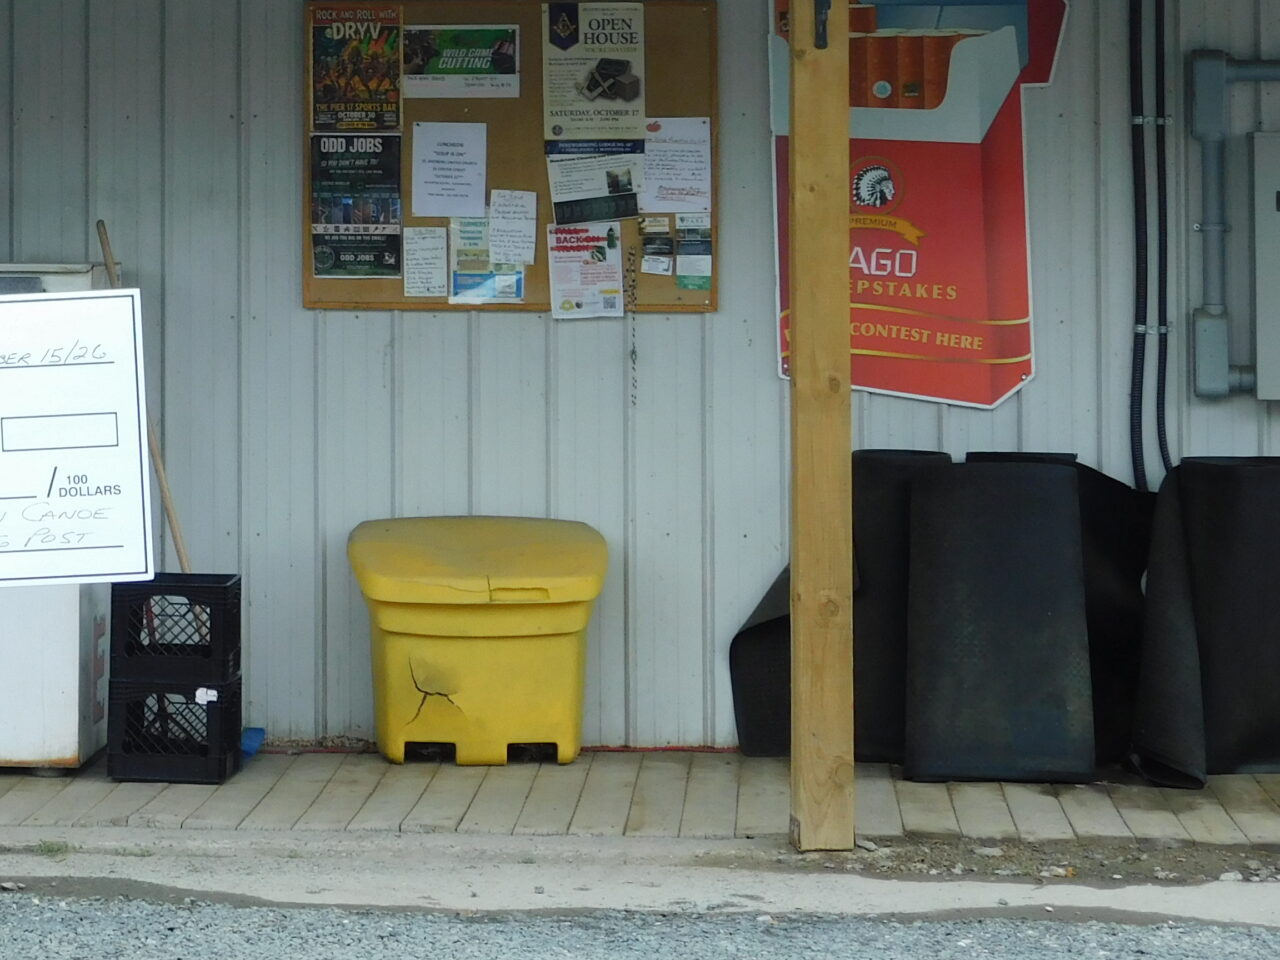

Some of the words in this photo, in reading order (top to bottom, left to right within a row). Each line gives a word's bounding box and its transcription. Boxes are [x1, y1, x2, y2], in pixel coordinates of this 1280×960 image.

[316, 9, 337, 20] ROCK
[356, 9, 376, 20] ROLL
[331, 22, 381, 40] DRYV
[588, 18, 632, 31] OPEN
[583, 32, 639, 45] HOUSE
[443, 48, 467, 57] WILD
[438, 57, 493, 69] CUTTING
[337, 111, 367, 119] OCTOBER
[320, 137, 346, 153] ODD
[349, 137, 384, 153] JOBS
[849, 246, 918, 277] AGO
[849, 279, 958, 300] PSTAKES
[850, 323, 931, 344] CONTEST
[935, 333, 985, 350] HERE
[39, 339, 108, 365] 15/26
[66, 474, 88, 485] 100
[58, 485, 122, 498] DOLLARS
[20, 502, 110, 522] CANOE
[23, 528, 92, 548] POST
